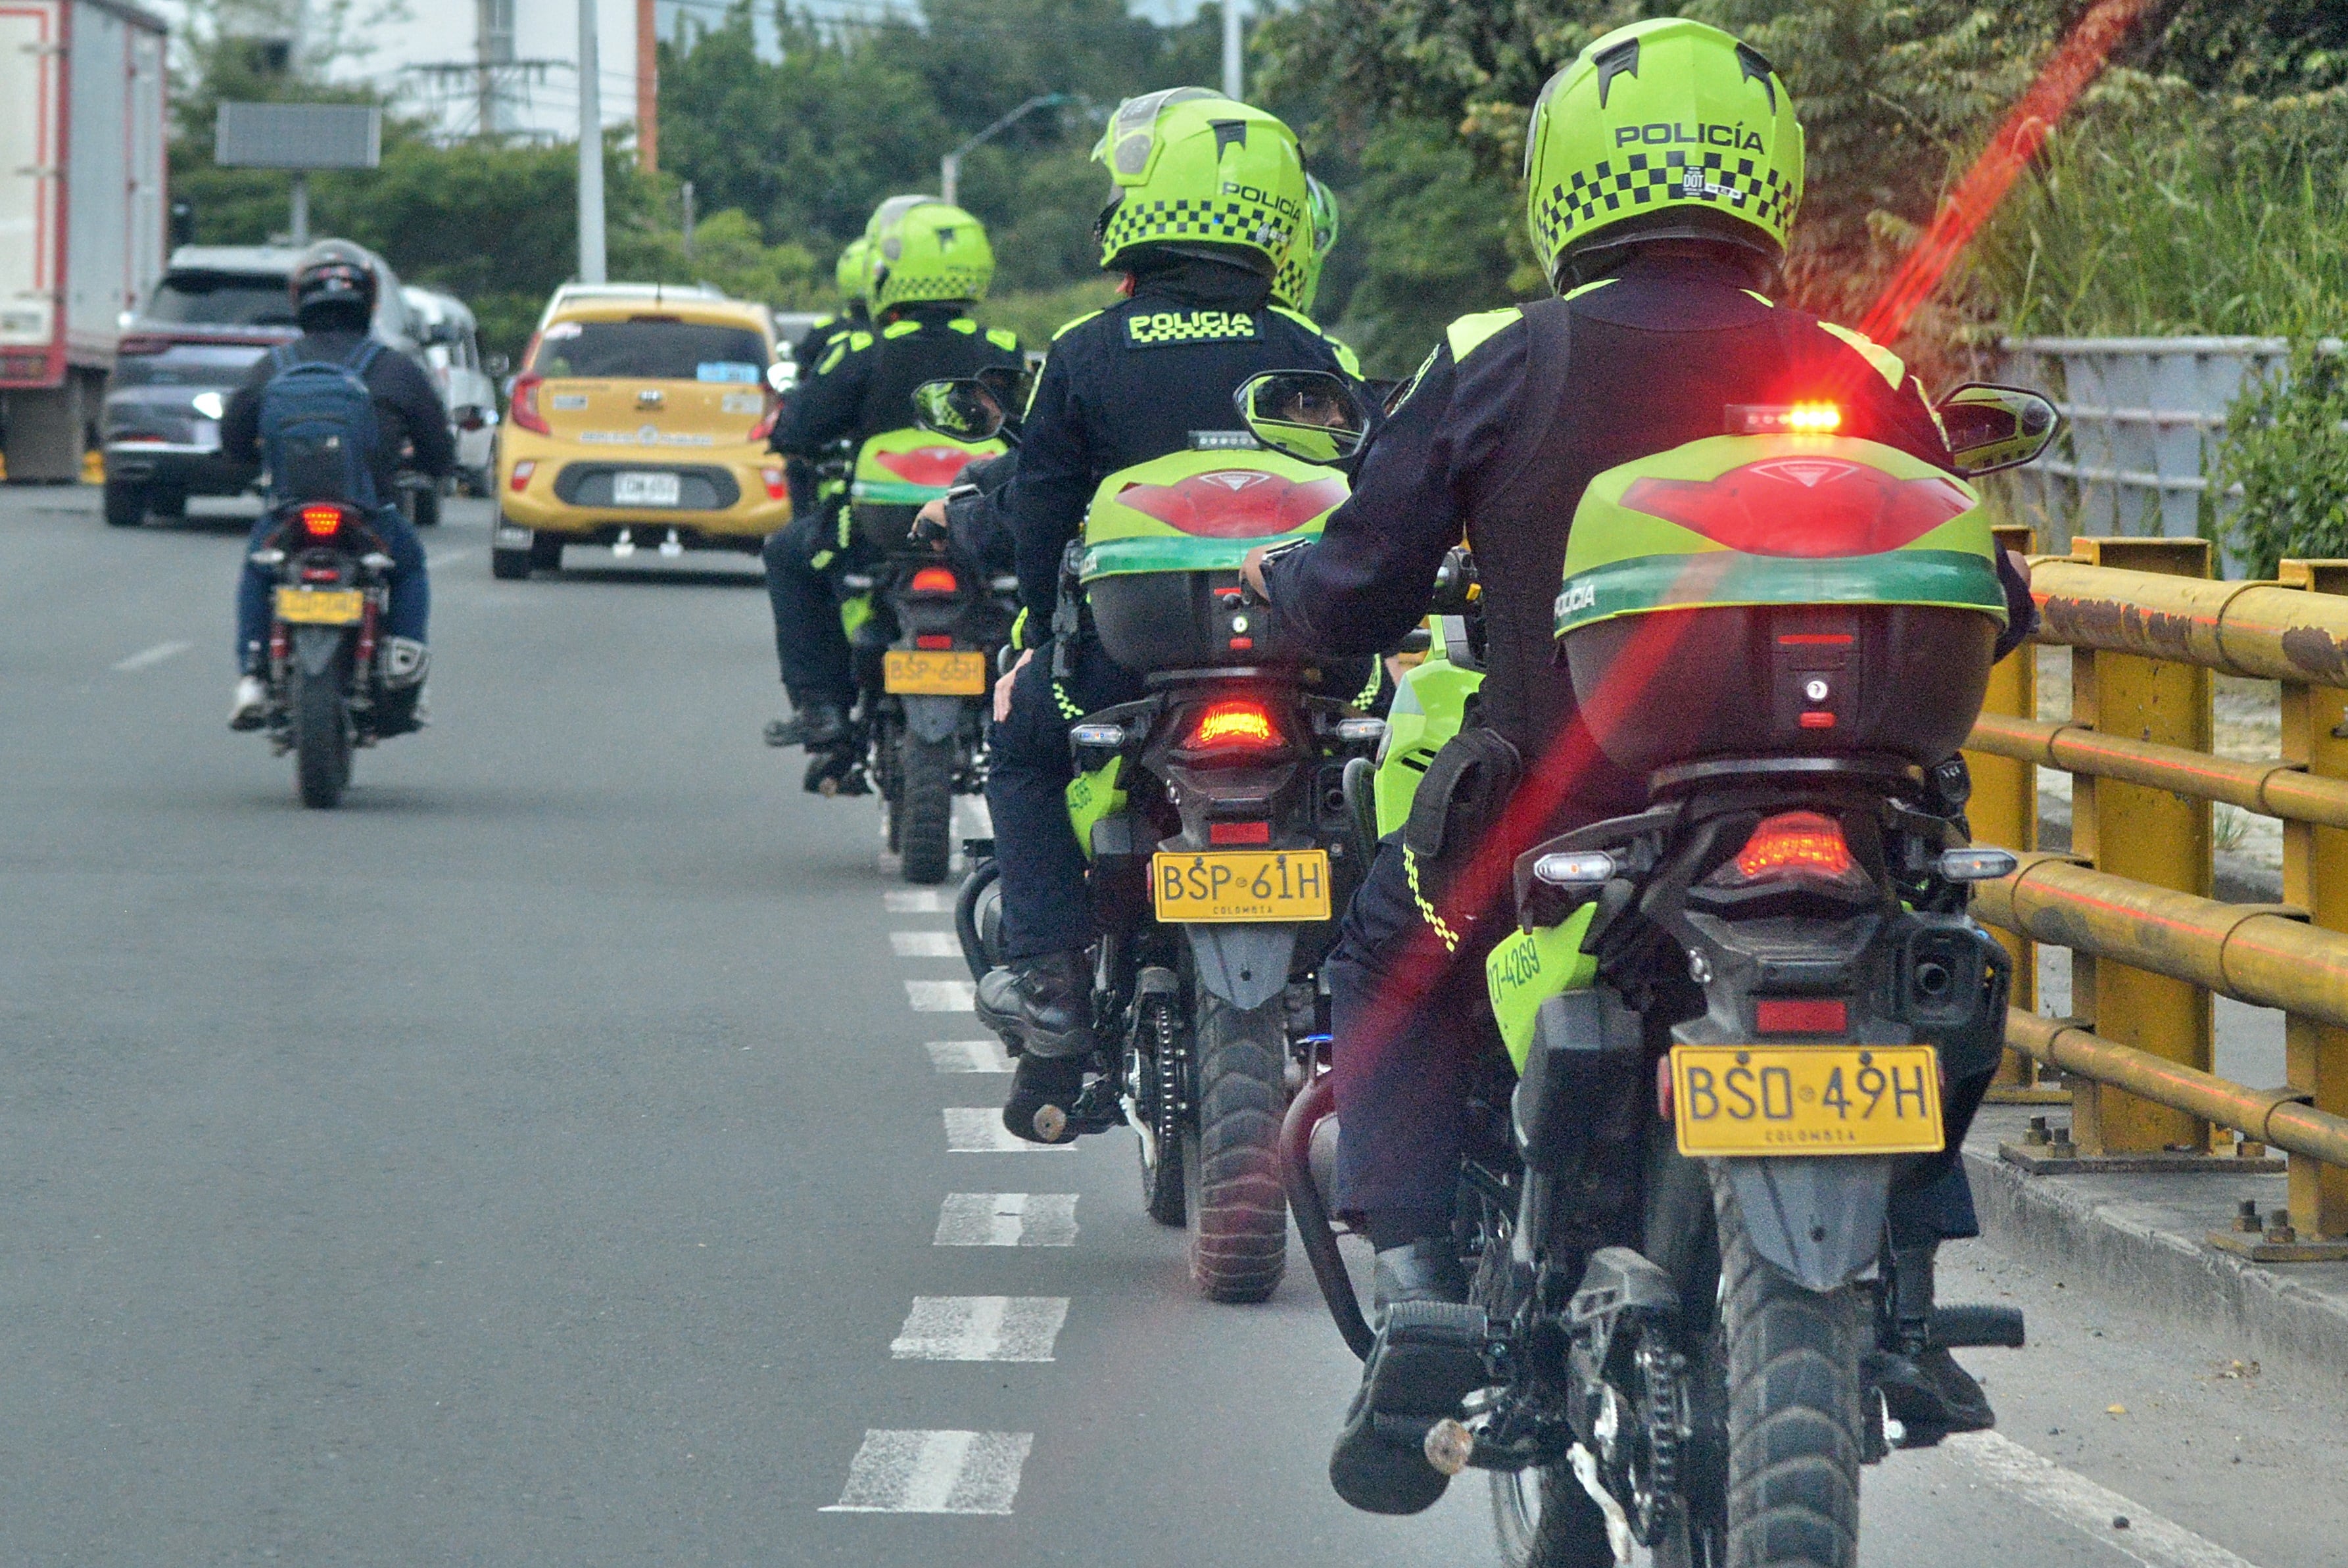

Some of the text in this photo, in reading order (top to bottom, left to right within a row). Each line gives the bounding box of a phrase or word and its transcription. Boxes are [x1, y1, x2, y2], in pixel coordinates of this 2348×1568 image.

[1615, 121, 1765, 155] POLICÍA
[1683, 174, 1704, 188] DOT
[1223, 181, 1301, 222] POLICÍA
[1129, 311, 1254, 334] POLICIA
[1163, 862, 1320, 901] BSP 61H
[1212, 905, 1273, 915] COLOMBIA
[1821, 1066, 1927, 1120] 49H
[1765, 1129, 1856, 1143] COLOMBIA
